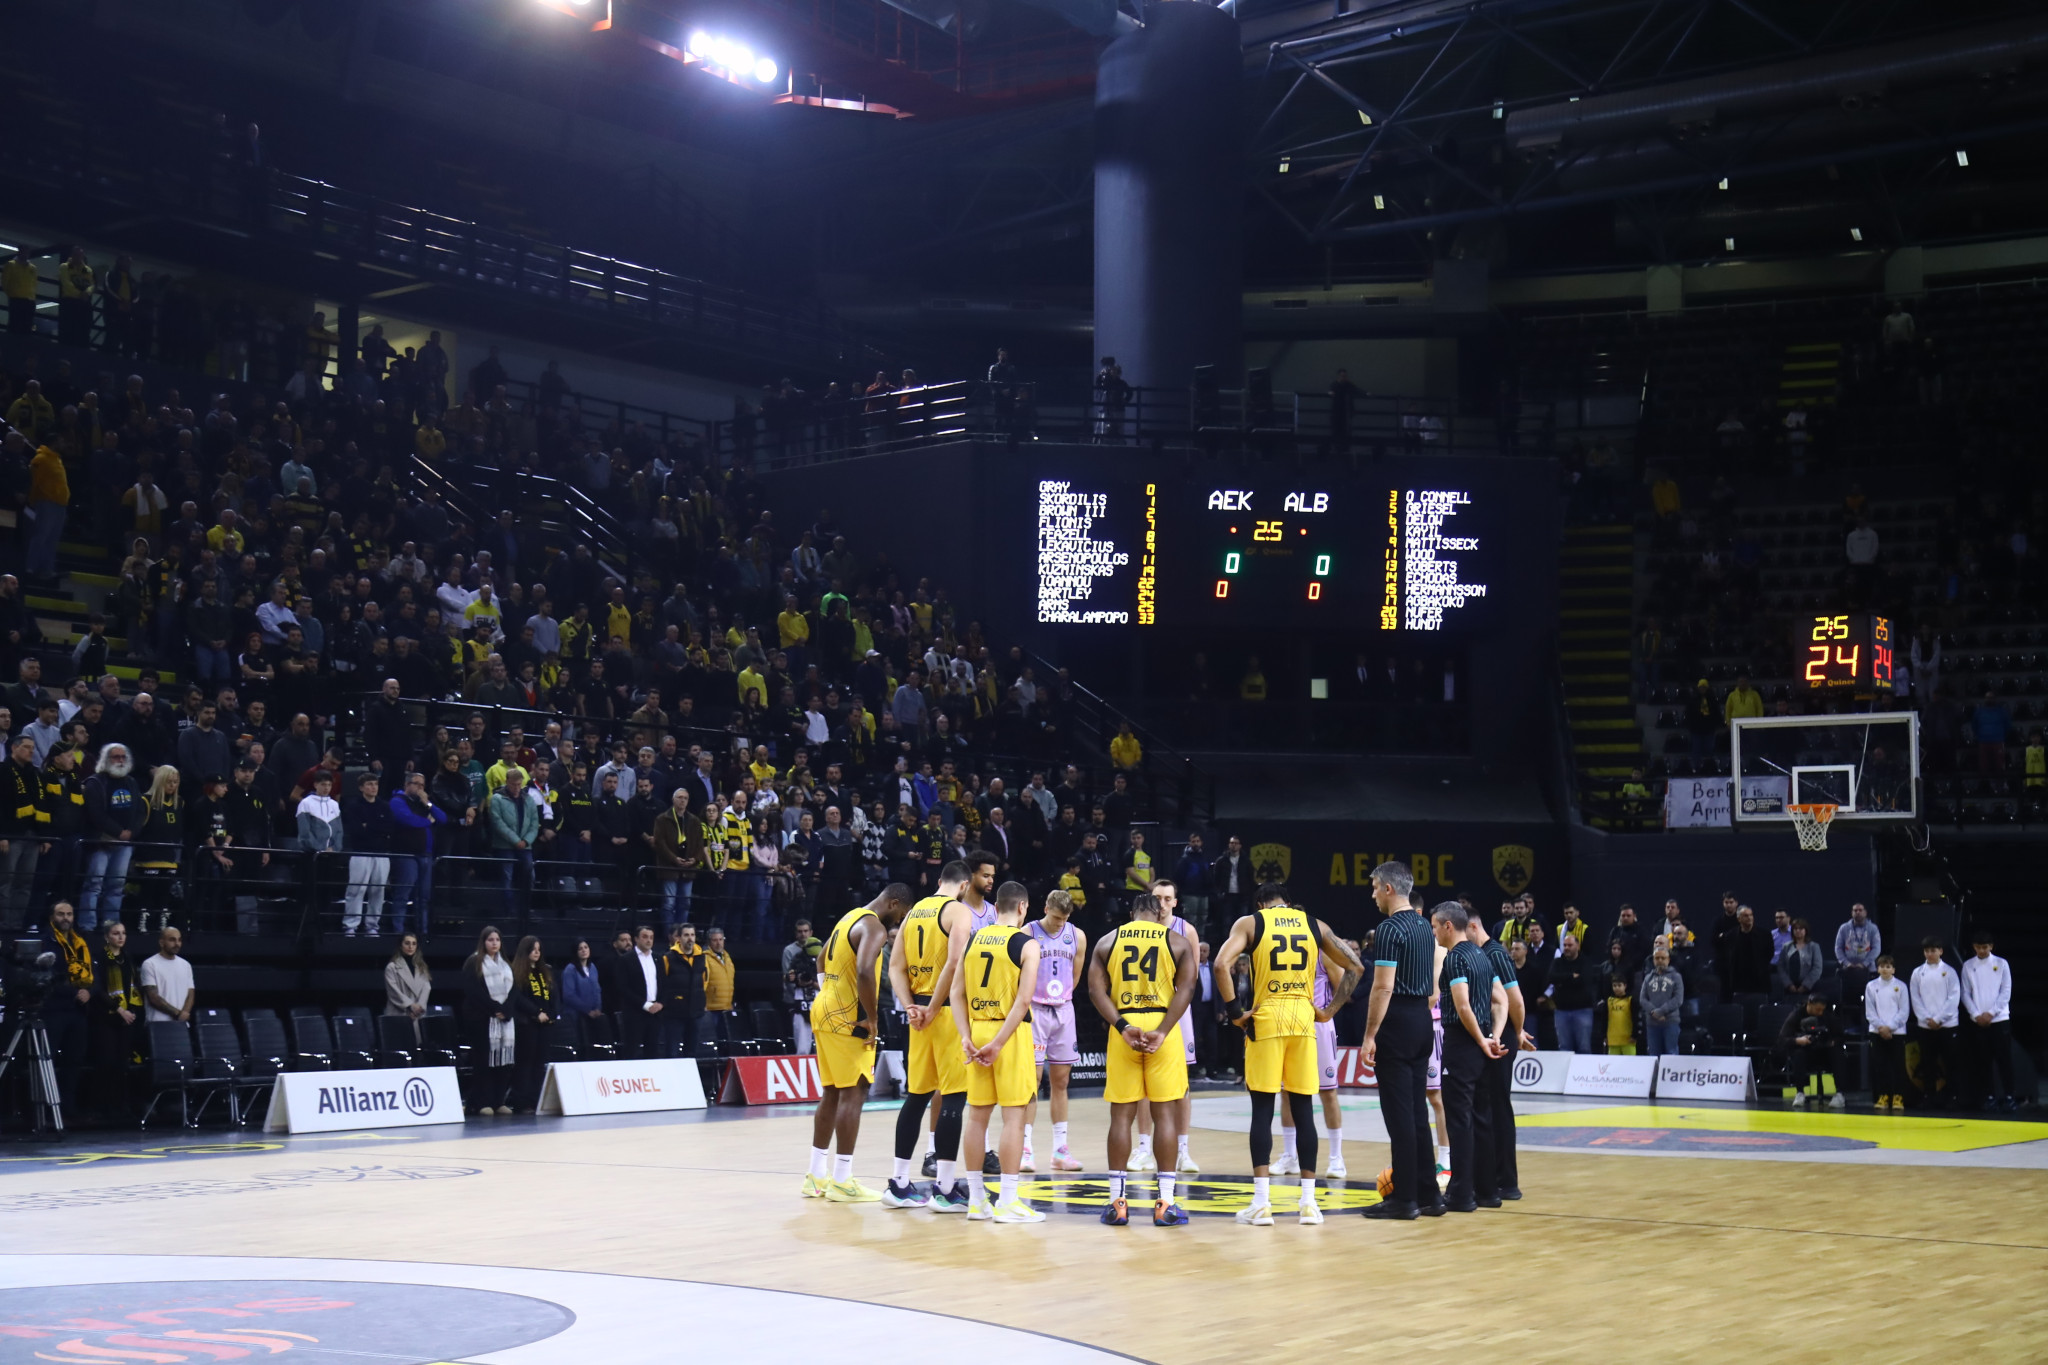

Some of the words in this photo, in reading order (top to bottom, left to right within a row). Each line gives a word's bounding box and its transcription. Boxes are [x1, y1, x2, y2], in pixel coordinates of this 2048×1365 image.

[1039, 481, 1070, 493] GRAY
[1146, 484, 1155, 495] 0
[1039, 494, 1107, 505] SKORDILIS
[1151, 497, 1155, 506] 1
[1208, 490, 1254, 511] AEK
[1284, 492, 1329, 512] ALB
[1390, 491, 1398, 502] 3
[1406, 491, 1414, 503] O
[1420, 491, 1471, 504] CONNELL
[1039, 506, 1077, 517] BROWN
[1084, 506, 1106, 517] III
[1146, 507, 1155, 518] 2
[1389, 503, 1397, 513] 5
[1406, 503, 1456, 515] GRIESEL
[1039, 517, 1092, 529] FLIONIS
[1148, 519, 1155, 530] 7
[1405, 514, 1443, 526] DELOW
[1039, 529, 1091, 540] FEAZELL
[1146, 531, 1155, 542] 8
[1390, 526, 1397, 536] 7
[1405, 526, 1442, 538] KAYIL
[1039, 540, 1114, 553] LEKAVICIUS
[1146, 543, 1155, 553] 9
[1389, 537, 1397, 548] 9
[1405, 538, 1479, 550] MATTISSECK
[1038, 553, 1129, 565] ARSENOPOULOS
[1386, 549, 1397, 559] 11
[1405, 549, 1435, 561] WOOD
[1038, 564, 1114, 576] KUZMINSKAS
[1225, 553, 1240, 574] 0
[1315, 555, 1330, 576] 0
[1386, 560, 1397, 571] 13
[1405, 560, 1457, 572] ROBERTS
[1039, 576, 1092, 587] IOANNOU
[1386, 572, 1397, 582] 14
[1405, 572, 1457, 584] ECHODAS
[1038, 587, 1092, 599] BARTLEY
[1216, 581, 1228, 598] 0
[1308, 582, 1320, 600] 0
[1386, 584, 1397, 594] 15
[1405, 583, 1486, 596] HERMANNSSON
[1038, 599, 1069, 611] ARMS
[1386, 595, 1397, 605] 17
[1405, 595, 1464, 608] AGBAKOKO
[1038, 611, 1128, 623] CHARALAMPOPO
[1381, 606, 1397, 618] 20
[1405, 606, 1442, 618] NUFER
[1381, 618, 1397, 630] 33
[1405, 618, 1442, 630] HUNDT
[1805, 644, 1859, 680] 24
[1874, 645, 1892, 679] 24
[1693, 782, 1747, 799] Berln
[1412, 854, 1454, 886] BC
[1275, 918, 1301, 928] ARMS
[975, 934, 1007, 946] FLIONIS
[1120, 930, 1164, 939] BARTLEY
[918, 924, 924, 959] 1
[1040, 950, 1052, 958] LBA
[1270, 934, 1308, 971] 25
[980, 951, 994, 988] 7
[1052, 960, 1058, 976] 5
[1122, 946, 1158, 982] 24
[767, 1058, 824, 1100] AVI
[611, 1078, 661, 1095] SUNEL
[318, 1086, 400, 1115] Allianz
